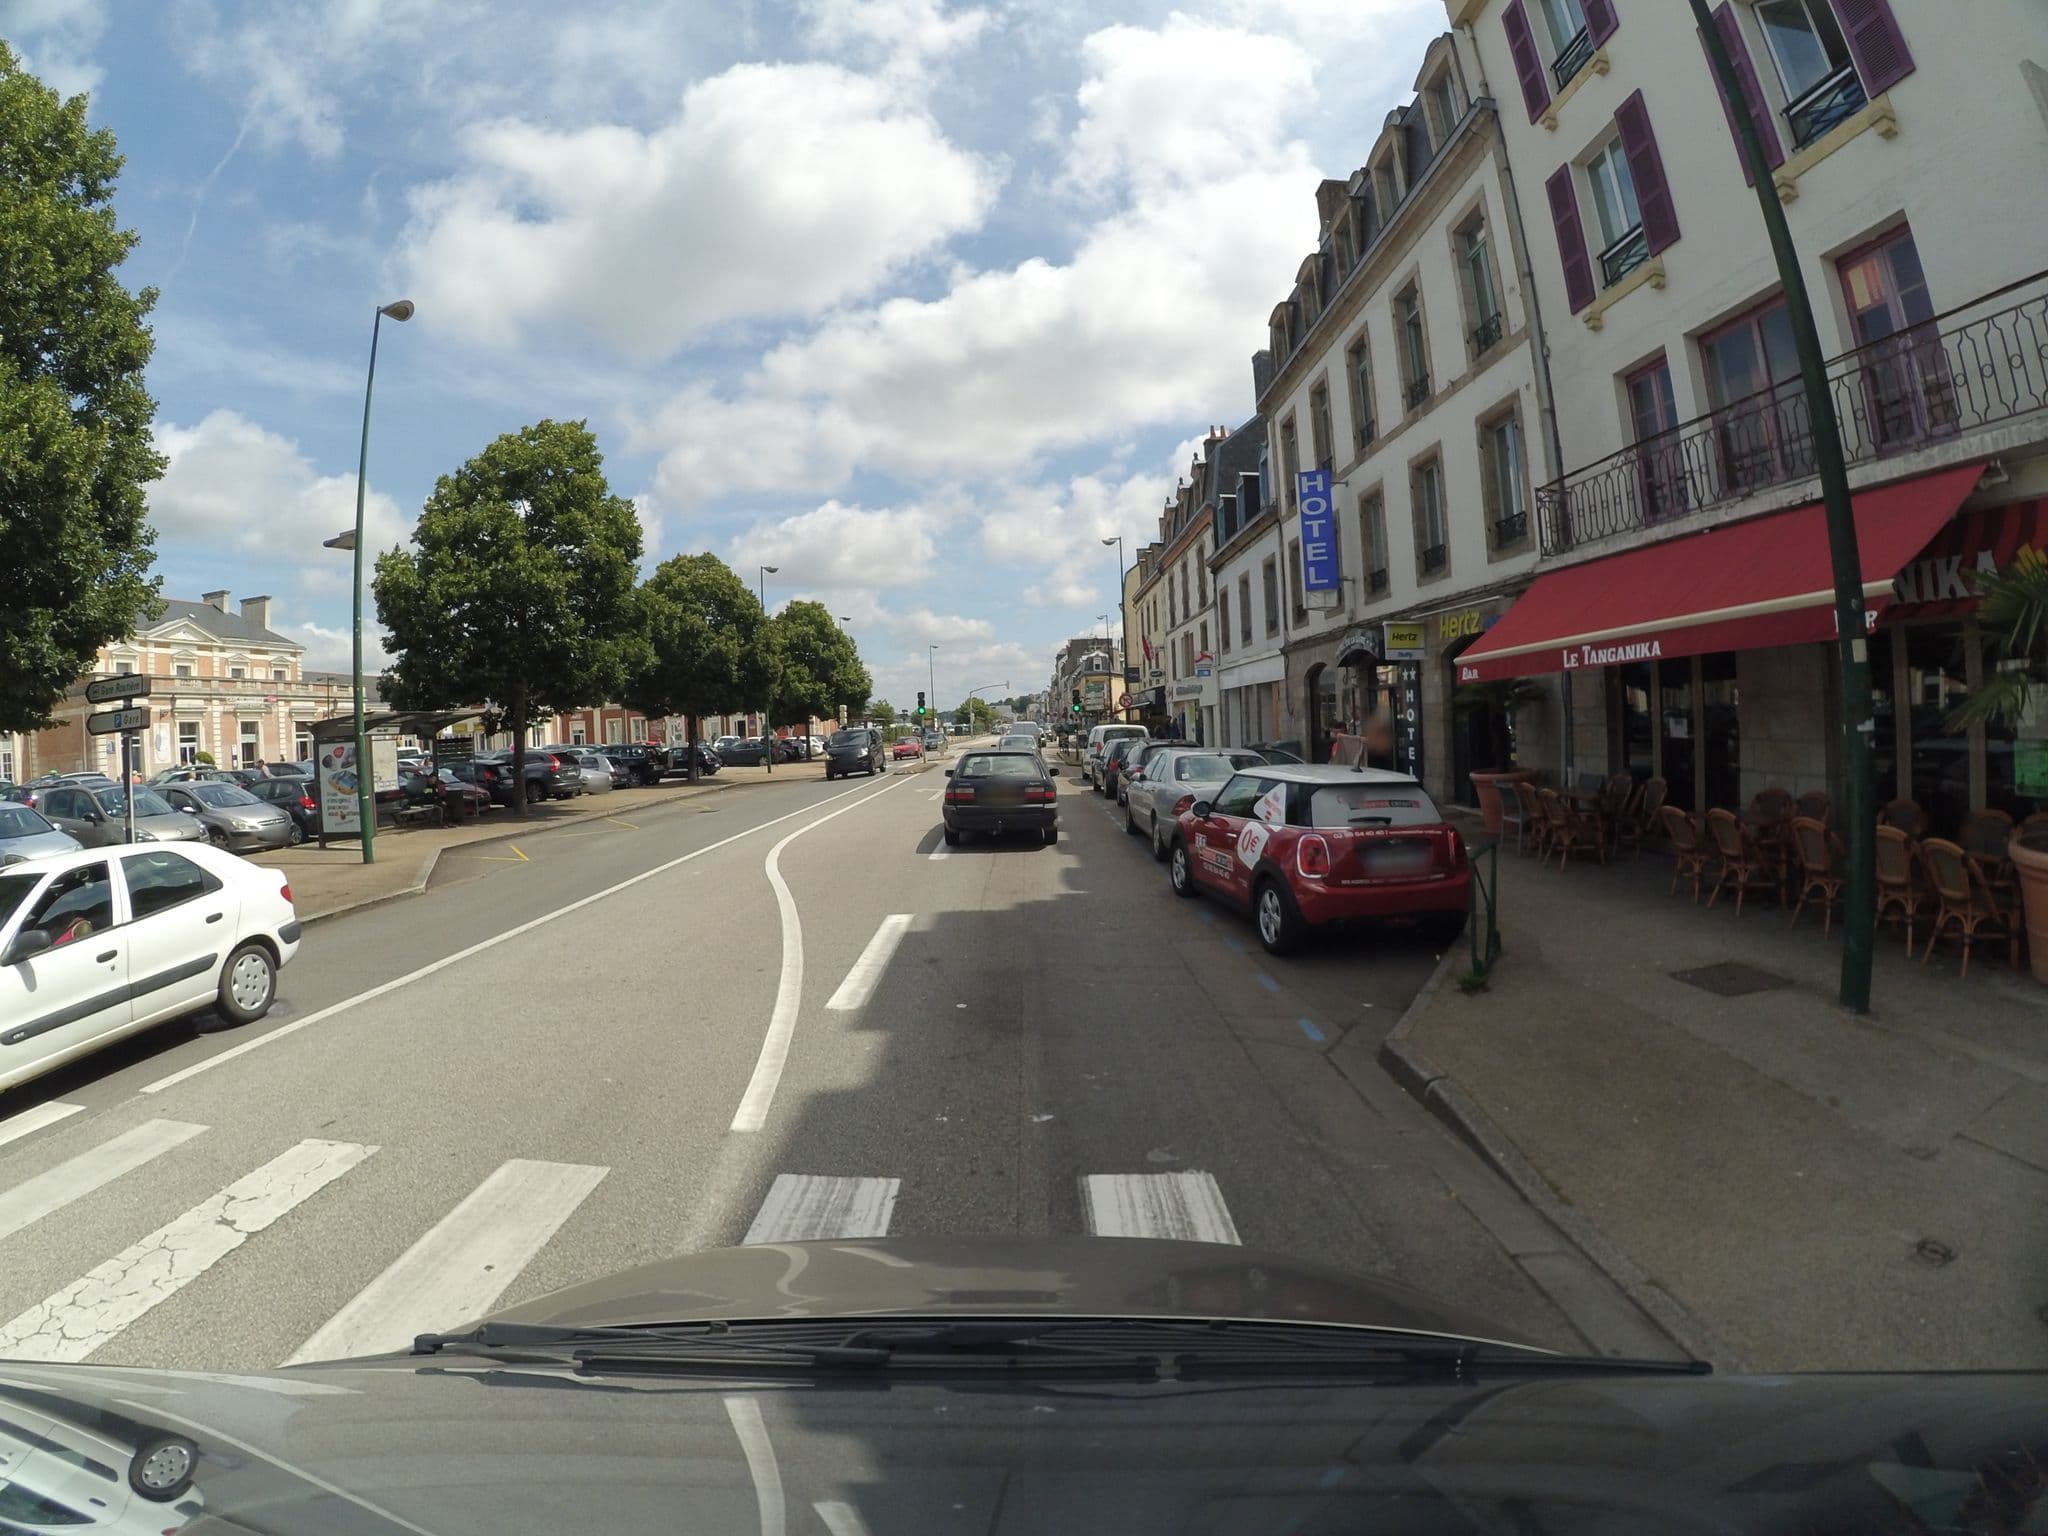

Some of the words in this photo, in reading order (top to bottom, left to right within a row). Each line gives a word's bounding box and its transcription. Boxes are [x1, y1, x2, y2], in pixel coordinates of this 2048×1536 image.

[1301, 474, 1329, 584] HOTEL
[1440, 608, 1481, 639] Hertz
[1392, 632, 1418, 641] Hertz
[123, 714, 139, 725] Gare
